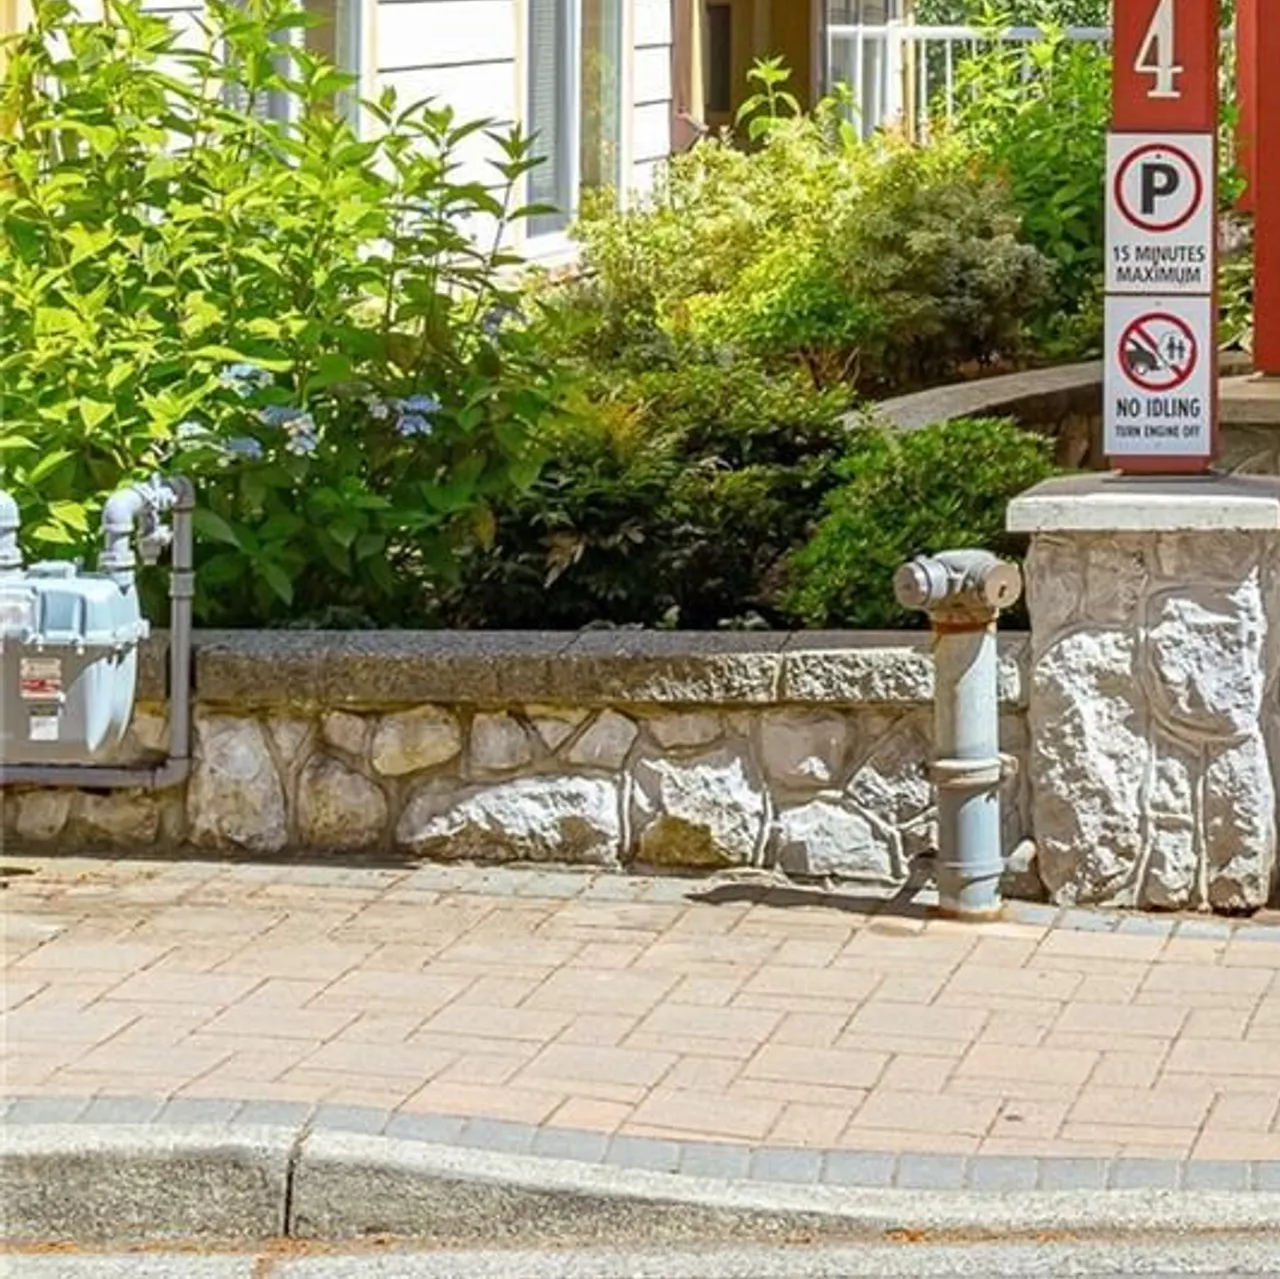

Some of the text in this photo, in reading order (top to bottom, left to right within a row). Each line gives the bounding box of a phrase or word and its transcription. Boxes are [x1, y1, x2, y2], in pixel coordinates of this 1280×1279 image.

[1140, 162, 1179, 215] P
[1112, 246, 1206, 263] 15 MINUTES
[1116, 265, 1201, 283] MAXIMUM
[1116, 398, 1201, 418] NO IDLING
[1115, 425, 1201, 438] TURN ENGINE OFF
